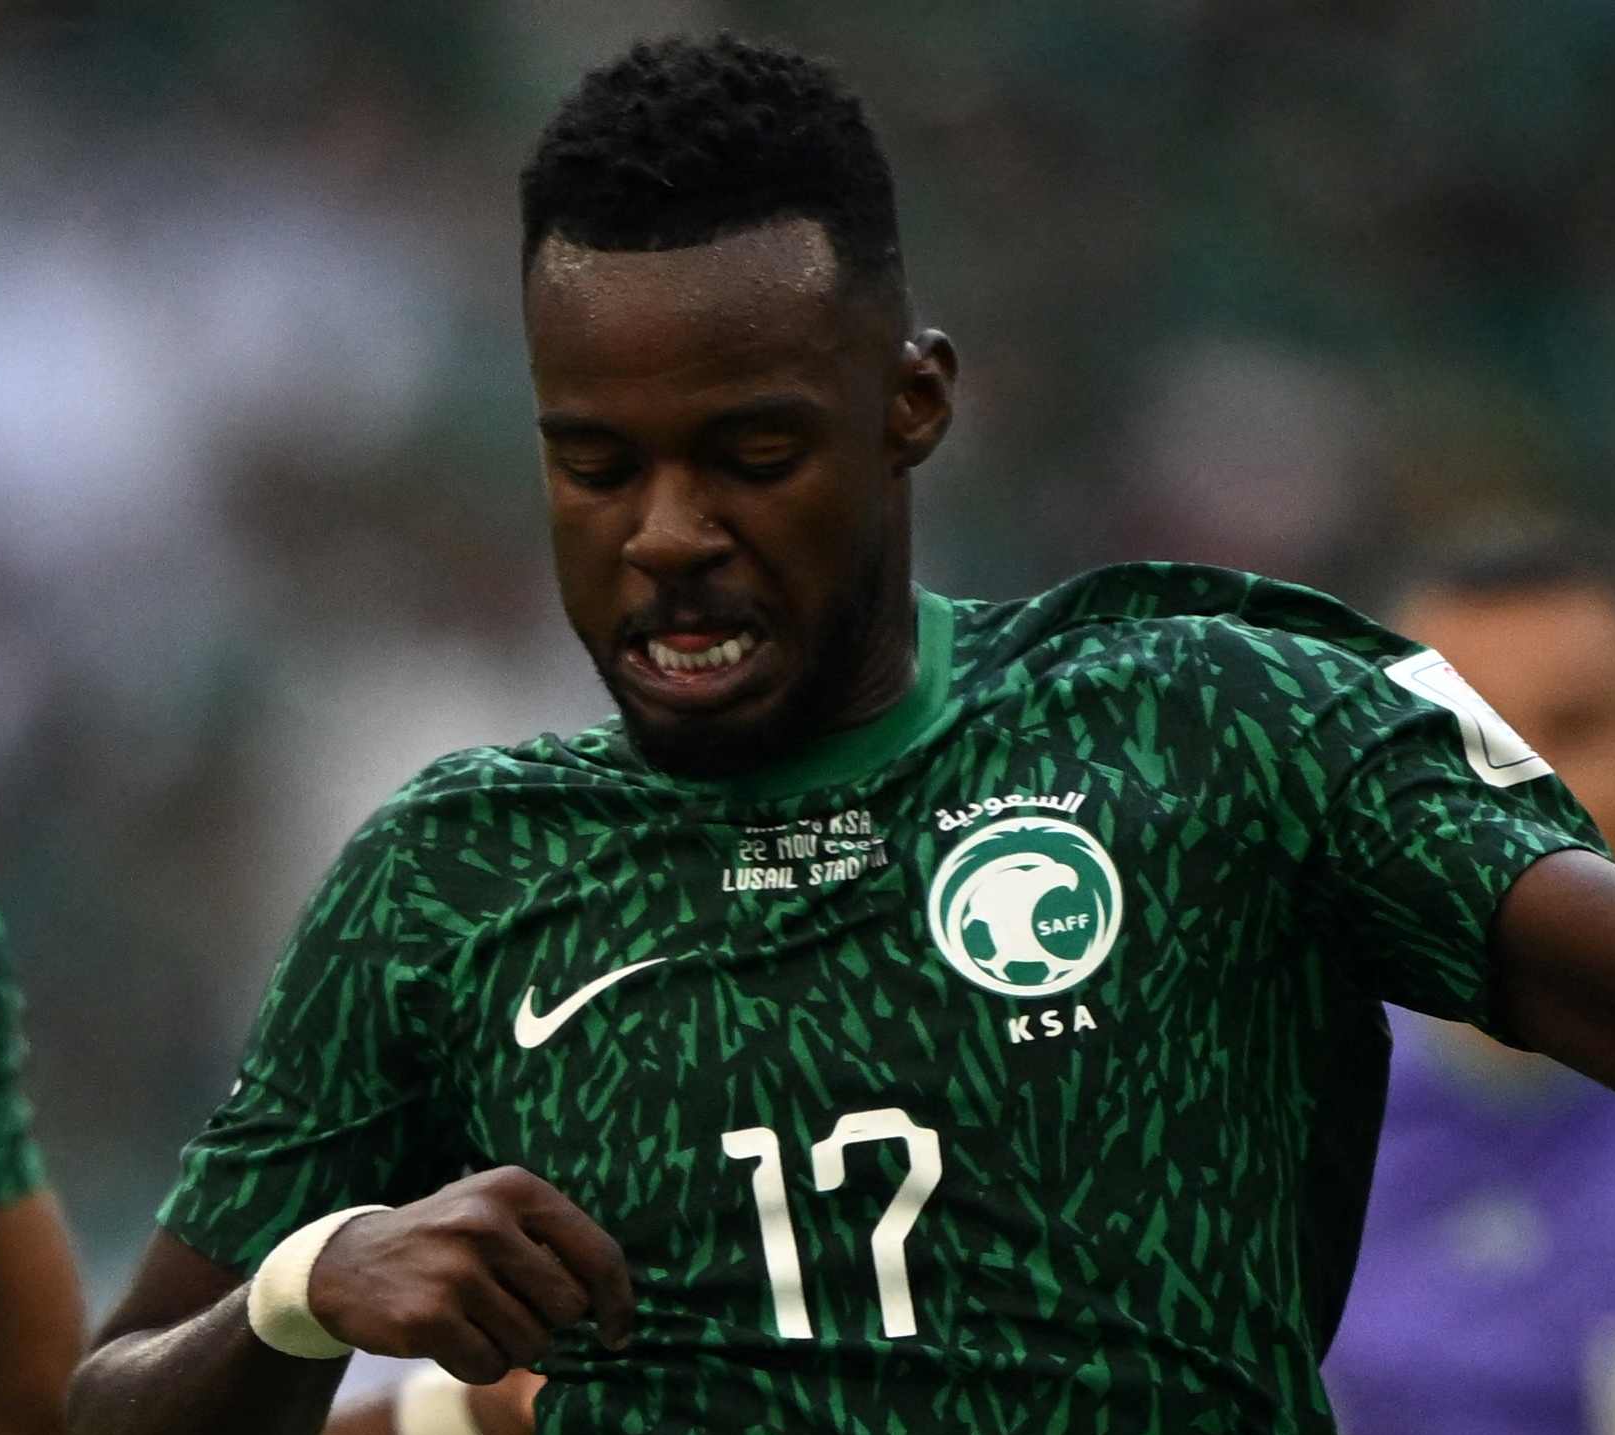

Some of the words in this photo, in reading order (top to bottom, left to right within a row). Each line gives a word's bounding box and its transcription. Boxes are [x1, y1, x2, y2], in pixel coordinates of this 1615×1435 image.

[829, 810, 871, 835] KSA
[934, 791, 1087, 831] السعودية
[739, 840, 768, 861] 22
[722, 867, 798, 892] LUSAIL
[1037, 913, 1091, 936] SAFF
[1007, 1004, 1098, 1044] KSA
[720, 1107, 943, 1339] 17
